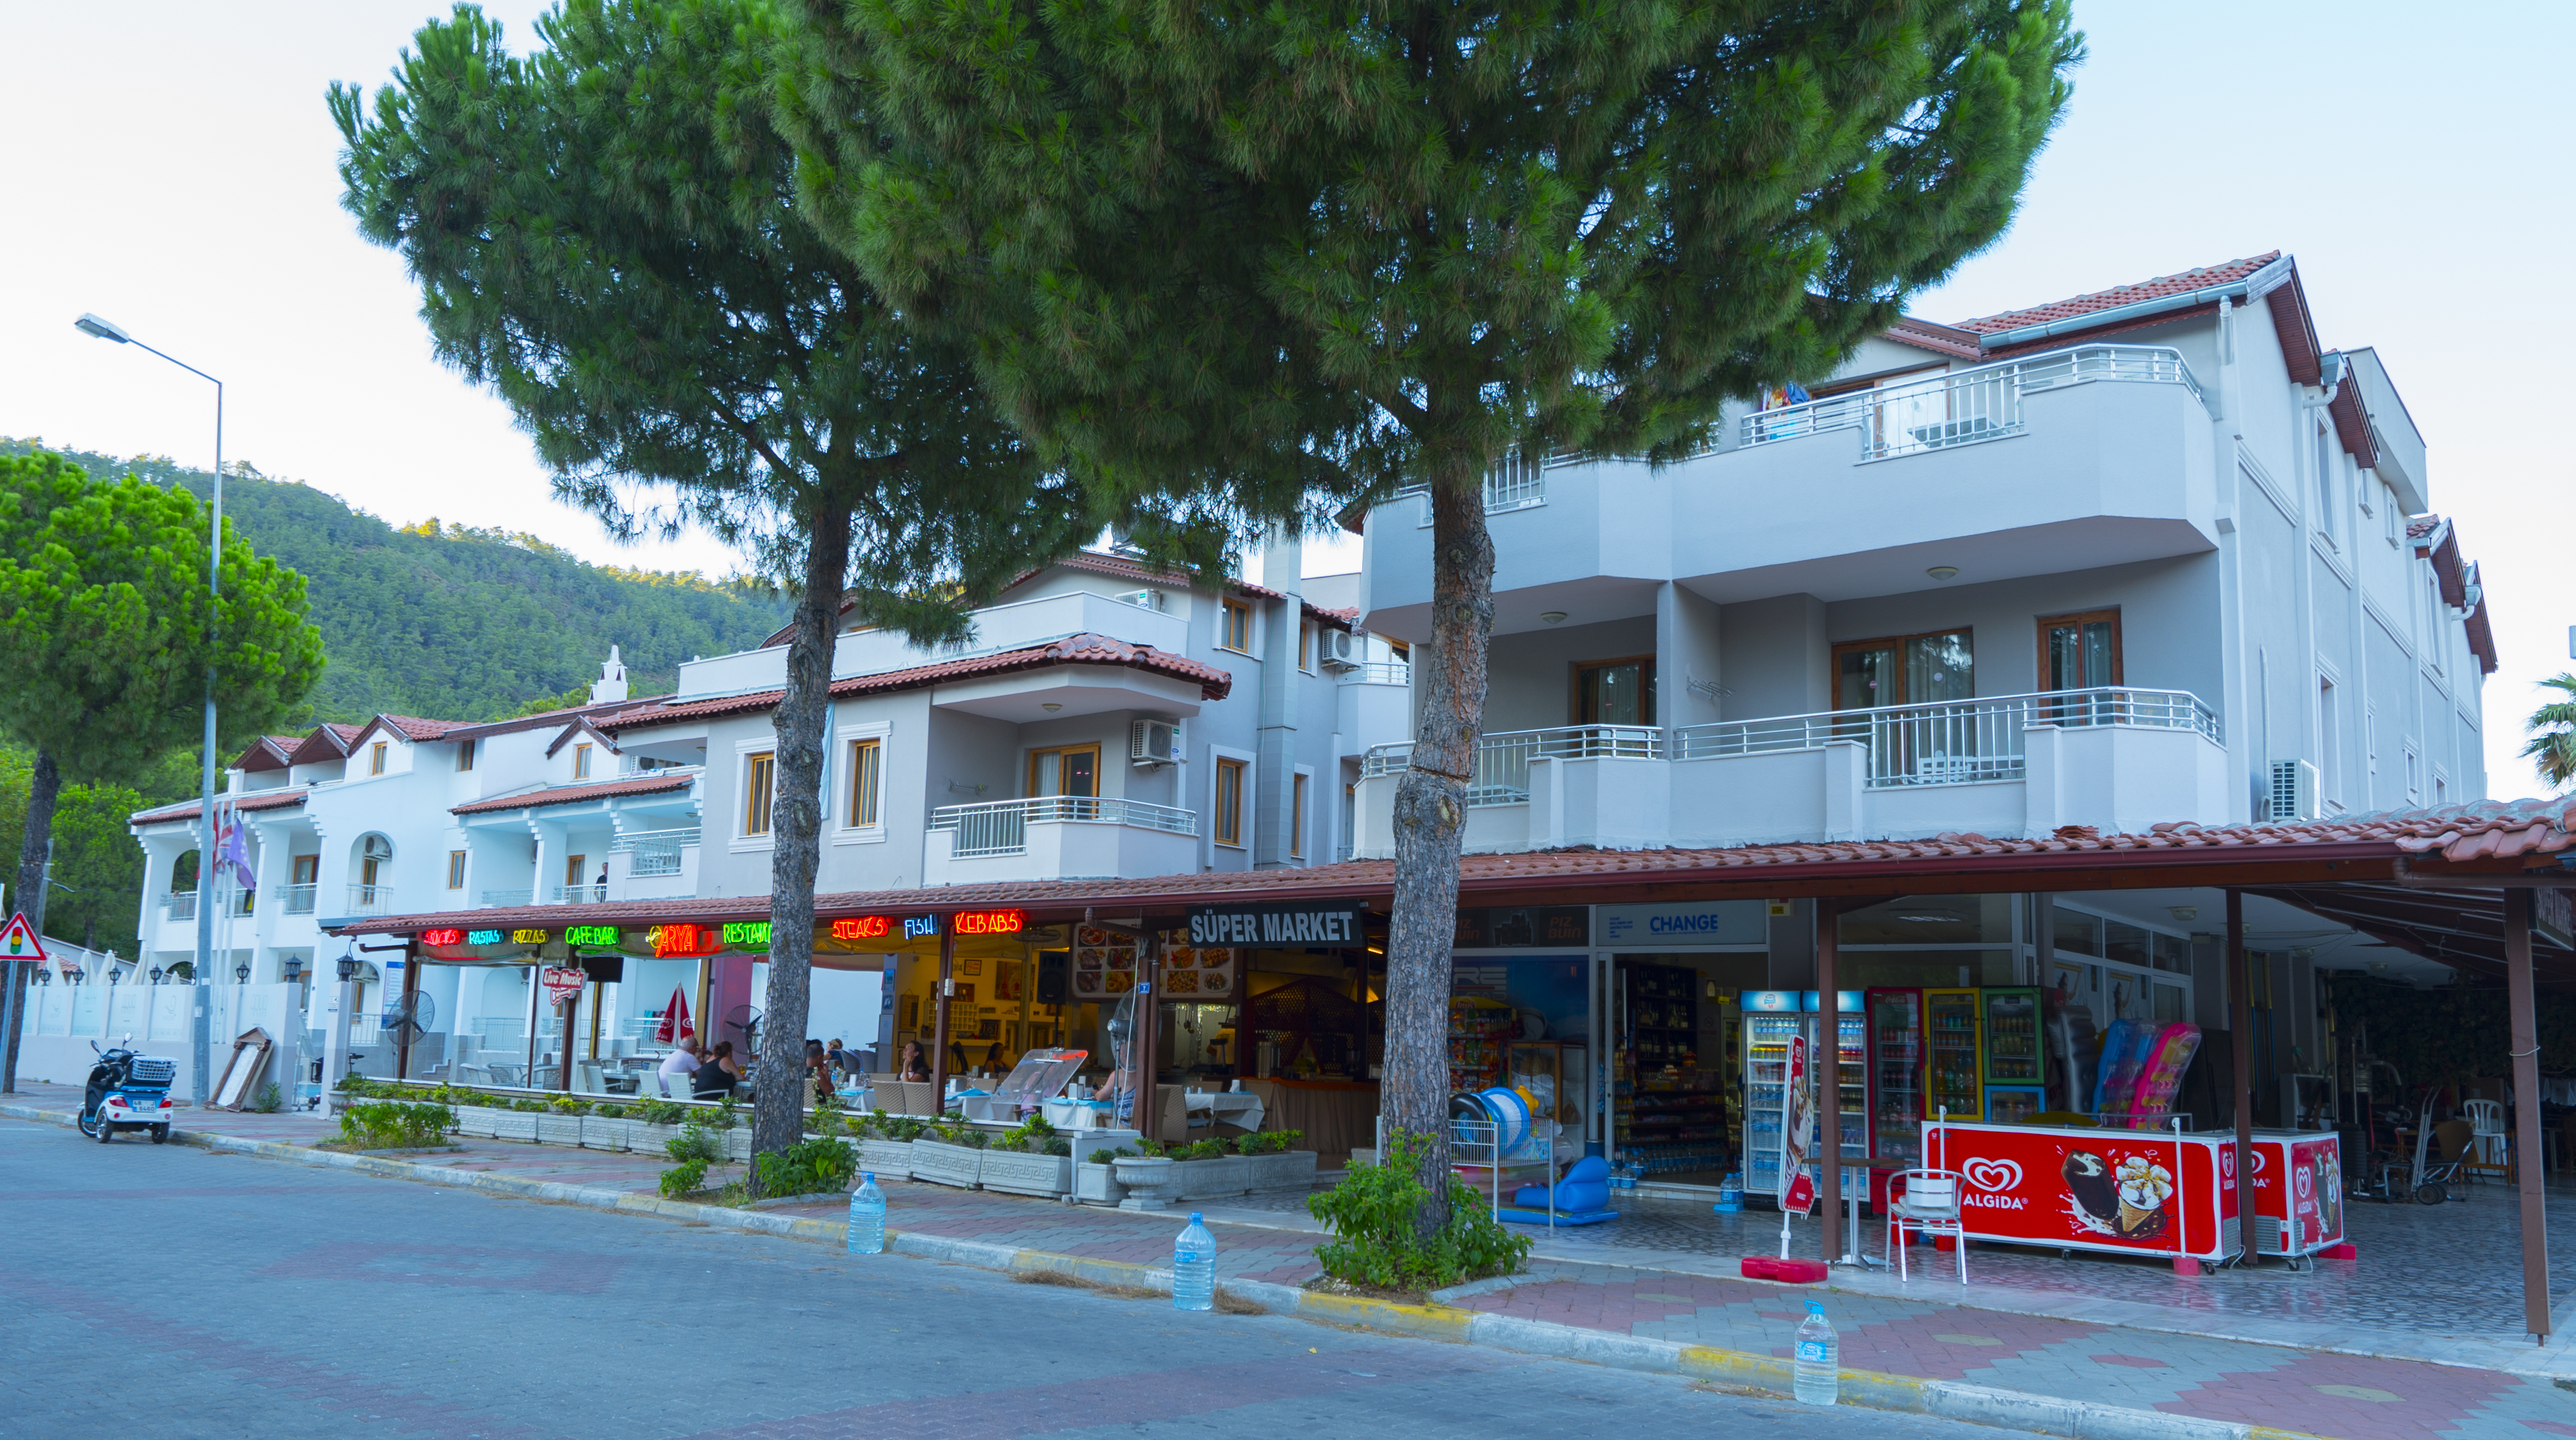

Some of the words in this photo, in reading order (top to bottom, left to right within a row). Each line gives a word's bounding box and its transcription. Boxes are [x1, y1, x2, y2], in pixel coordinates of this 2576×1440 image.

[832, 917, 883, 940] STEAKS
[905, 914, 934, 940] FISH
[955, 912, 1018, 933] KEBABS
[1191, 909, 1258, 943] SÜPER
[1263, 912, 1353, 942] MARKET
[1550, 916, 1573, 927] PIZ
[1650, 914, 1718, 932] CHANGE
[565, 926, 593, 945] CAFE
[594, 926, 617, 945] BAR
[655, 925, 693, 957] ARYA
[1454, 930, 1480, 940] UIN
[544, 970, 559, 984] Live
[560, 972, 582, 986] Music
